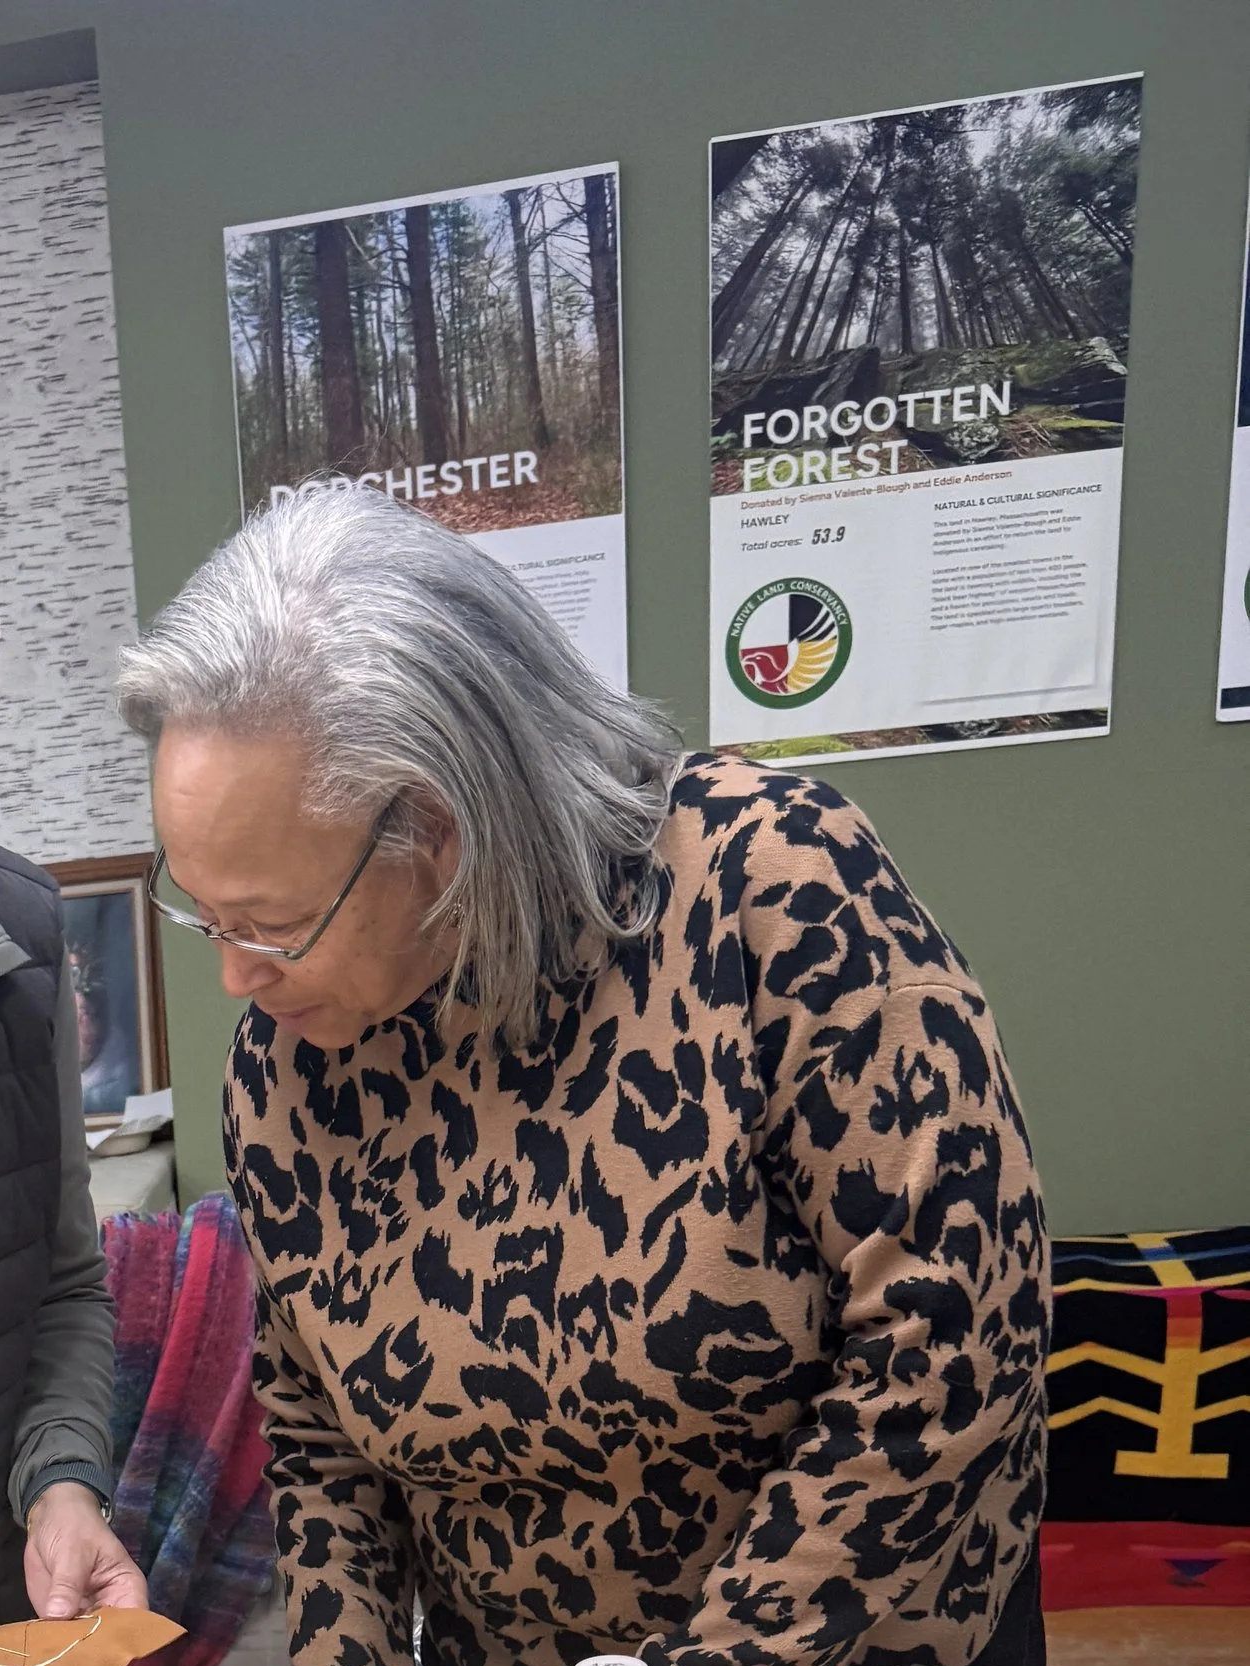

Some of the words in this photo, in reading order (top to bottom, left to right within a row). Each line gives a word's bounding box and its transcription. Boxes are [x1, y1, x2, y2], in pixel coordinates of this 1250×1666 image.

[743, 381, 1012, 448] FORGOTTEN
[743, 439, 909, 492] FOREST
[741, 497, 783, 511] Donated
[784, 495, 797, 507] by
[799, 491, 832, 503] Sienna
[913, 477, 932, 489] and
[933, 474, 962, 487] Eddie
[964, 469, 1013, 484] Anderson
[934, 499, 977, 511] NATURAL
[979, 497, 986, 506] &
[987, 492, 1035, 506] CULTURAL
[1036, 484, 1103, 500] SIGNIFICANCE
[741, 514, 790, 529] HAWLEY
[741, 541, 768, 552] Total
[769, 538, 803, 549] acres:
[811, 526, 846, 545] 53.9
[546, 552, 606, 567] SIGNIFICANCE
[730, 600, 755, 637] NATIVE
[757, 583, 786, 602] LAND
[789, 580, 849, 626] CONSERVANCY
